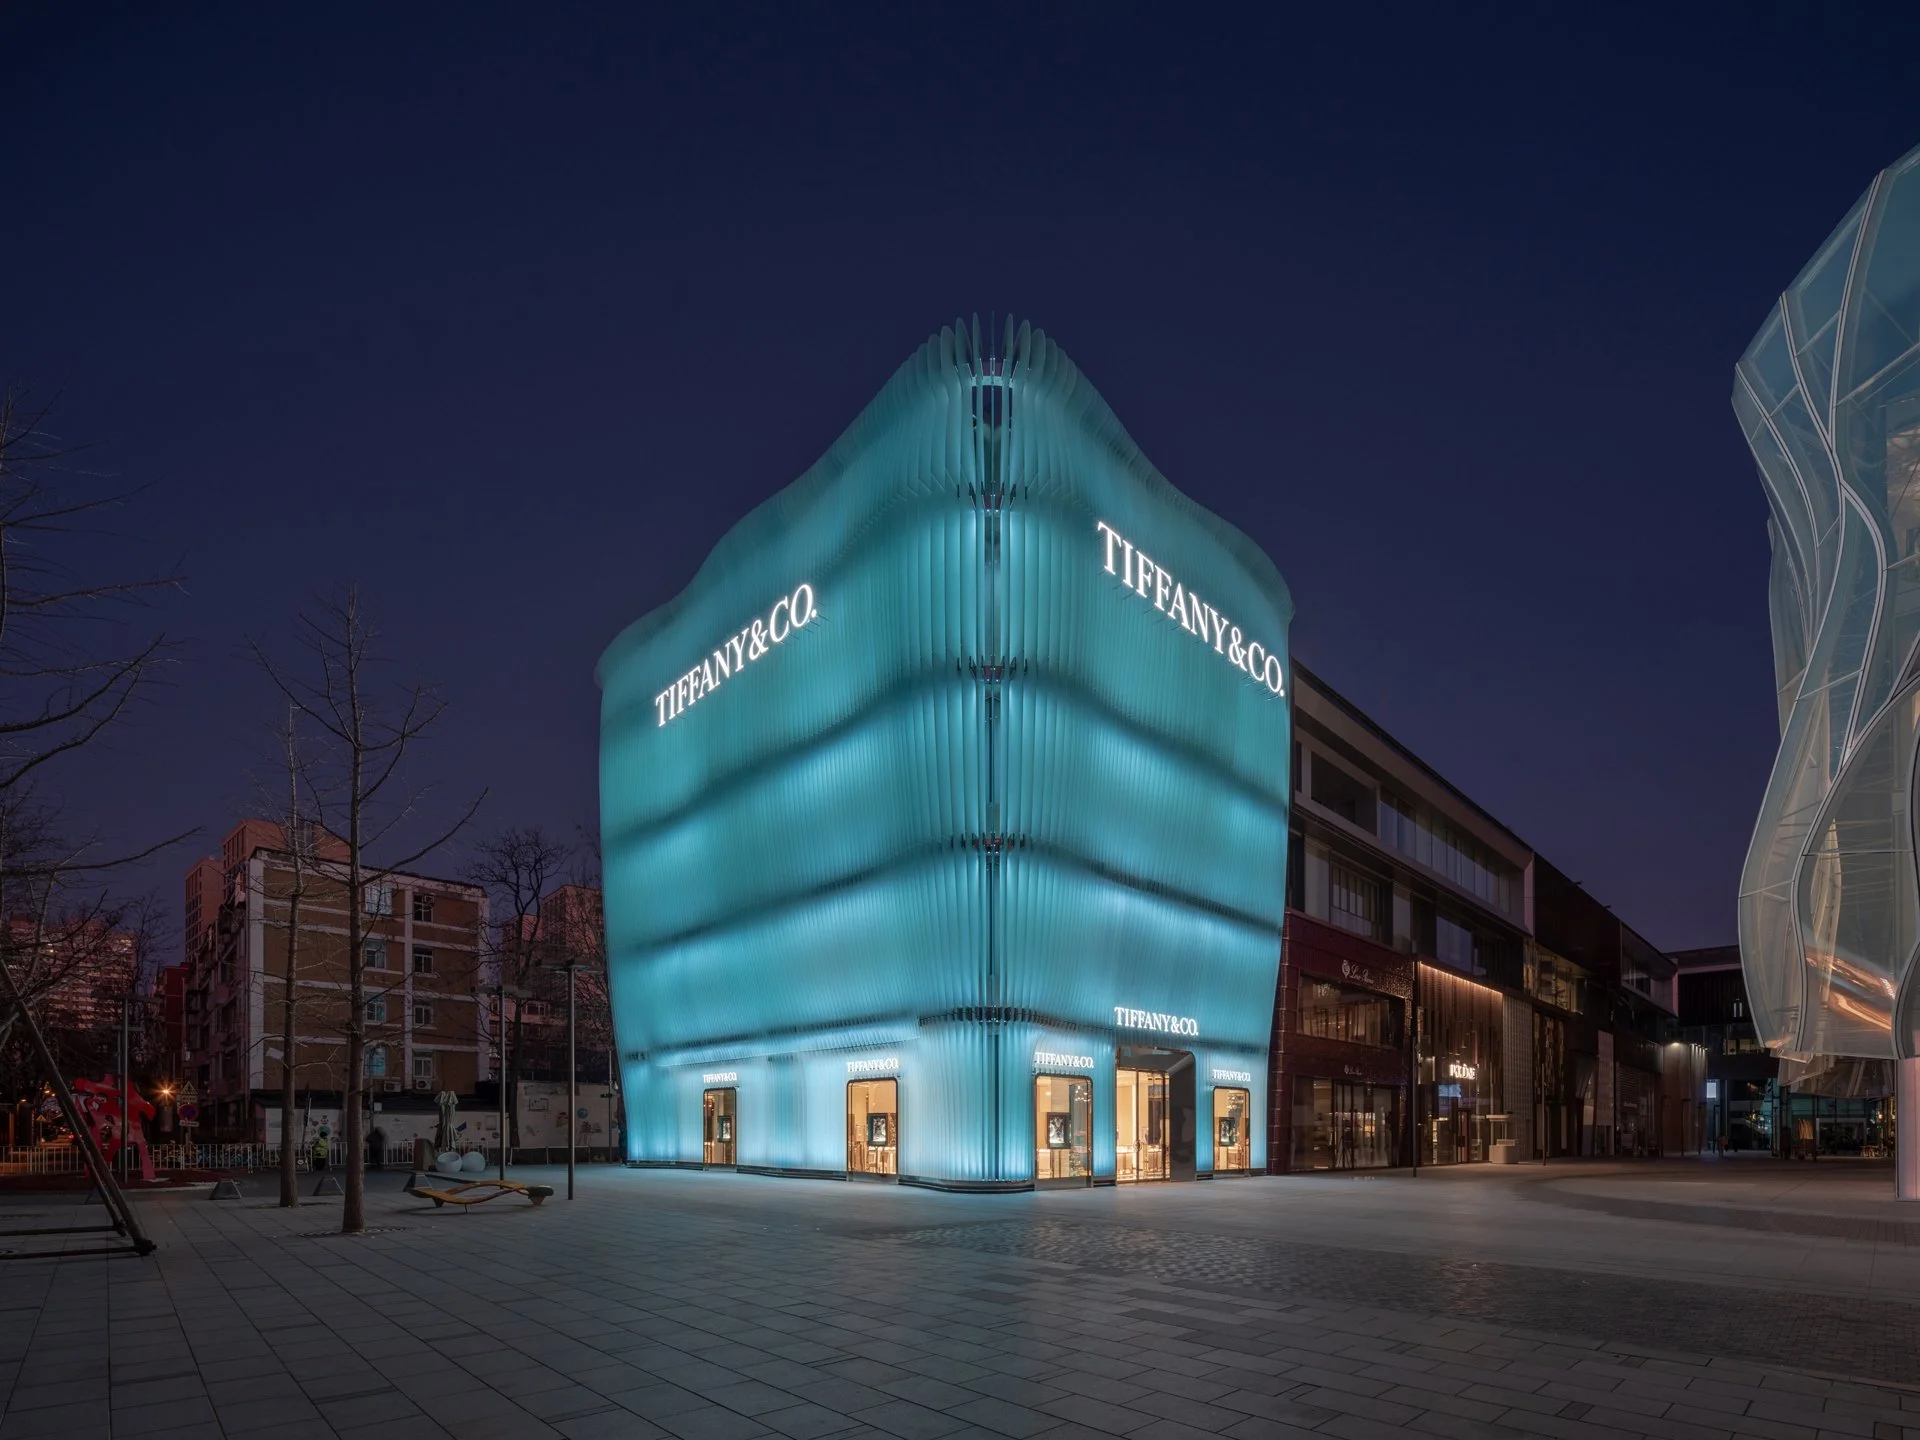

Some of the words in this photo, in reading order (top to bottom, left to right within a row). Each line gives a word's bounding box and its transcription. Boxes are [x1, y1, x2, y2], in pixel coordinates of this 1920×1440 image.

[1098, 521, 1285, 696] TIFFANY&CO.
[655, 584, 817, 727] TIFFANY&CO.
[1035, 1052, 1094, 1069] TIFFANY&CO.
[1114, 1007, 1198, 1036] TIFFANY&CO.
